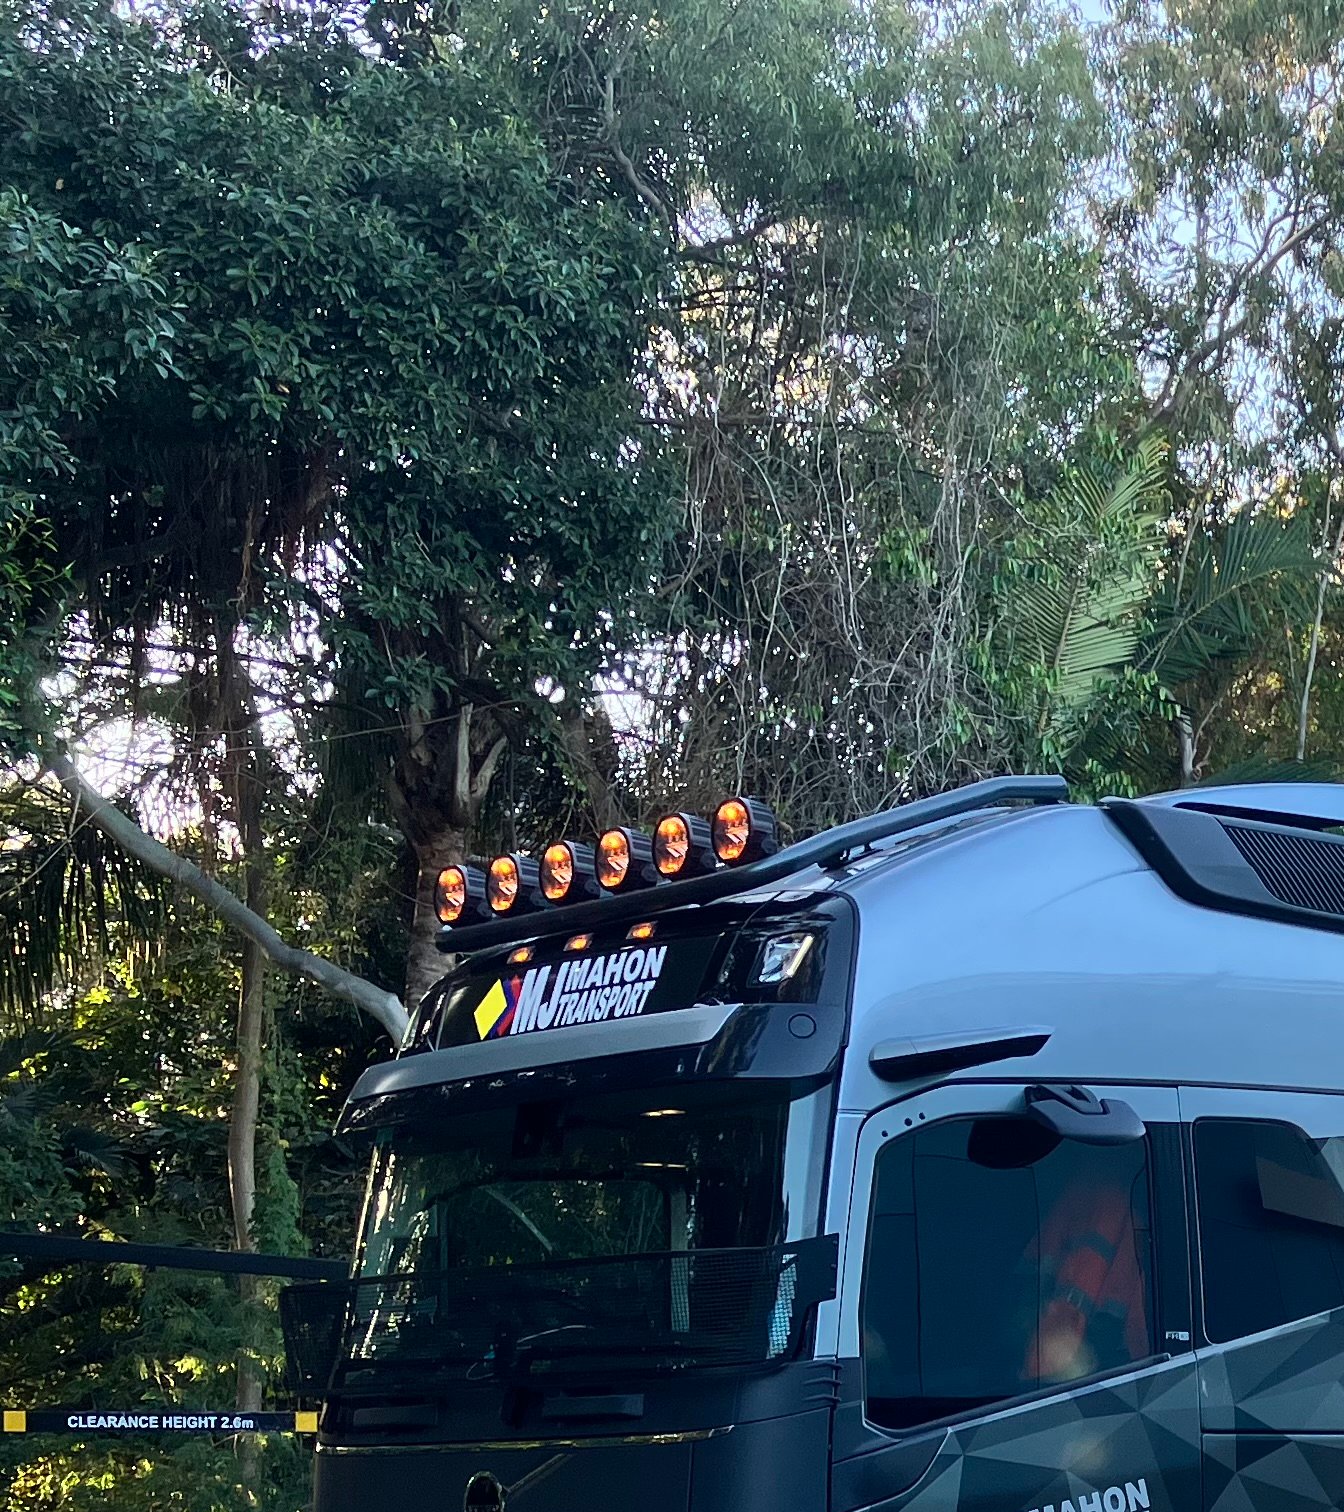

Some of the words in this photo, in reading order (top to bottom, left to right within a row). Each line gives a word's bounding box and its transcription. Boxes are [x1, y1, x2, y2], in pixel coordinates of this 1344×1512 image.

[509, 961, 571, 1035] MJ
[564, 945, 668, 993] MAHON
[553, 979, 657, 1027] TRANSPORT
[67, 1415, 159, 1429] CLEARANCE
[162, 1415, 218, 1429] HEIGHT
[220, 1416, 255, 1429] 2.6m
